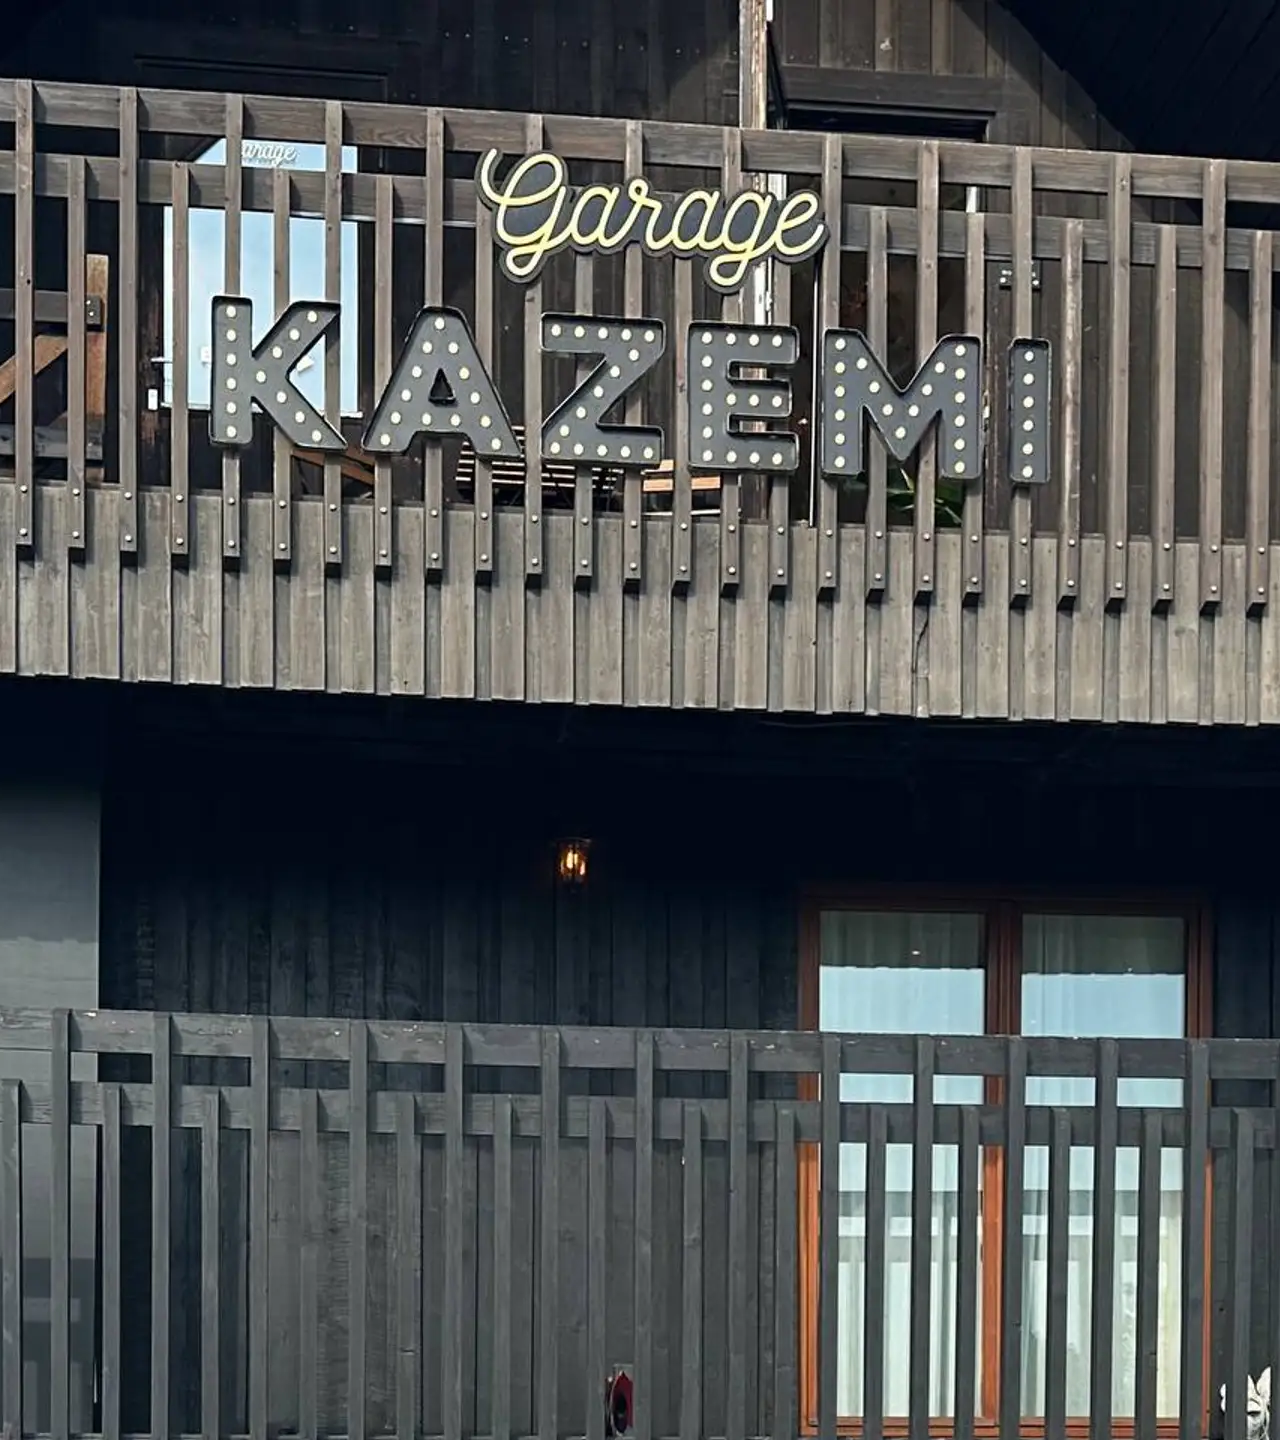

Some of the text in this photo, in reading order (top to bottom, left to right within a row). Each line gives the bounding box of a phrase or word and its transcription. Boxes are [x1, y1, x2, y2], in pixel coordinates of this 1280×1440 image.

[240, 142, 298, 166] arage
[481, 147, 828, 289] Garage
[210, 295, 1053, 485] KAZEMI
